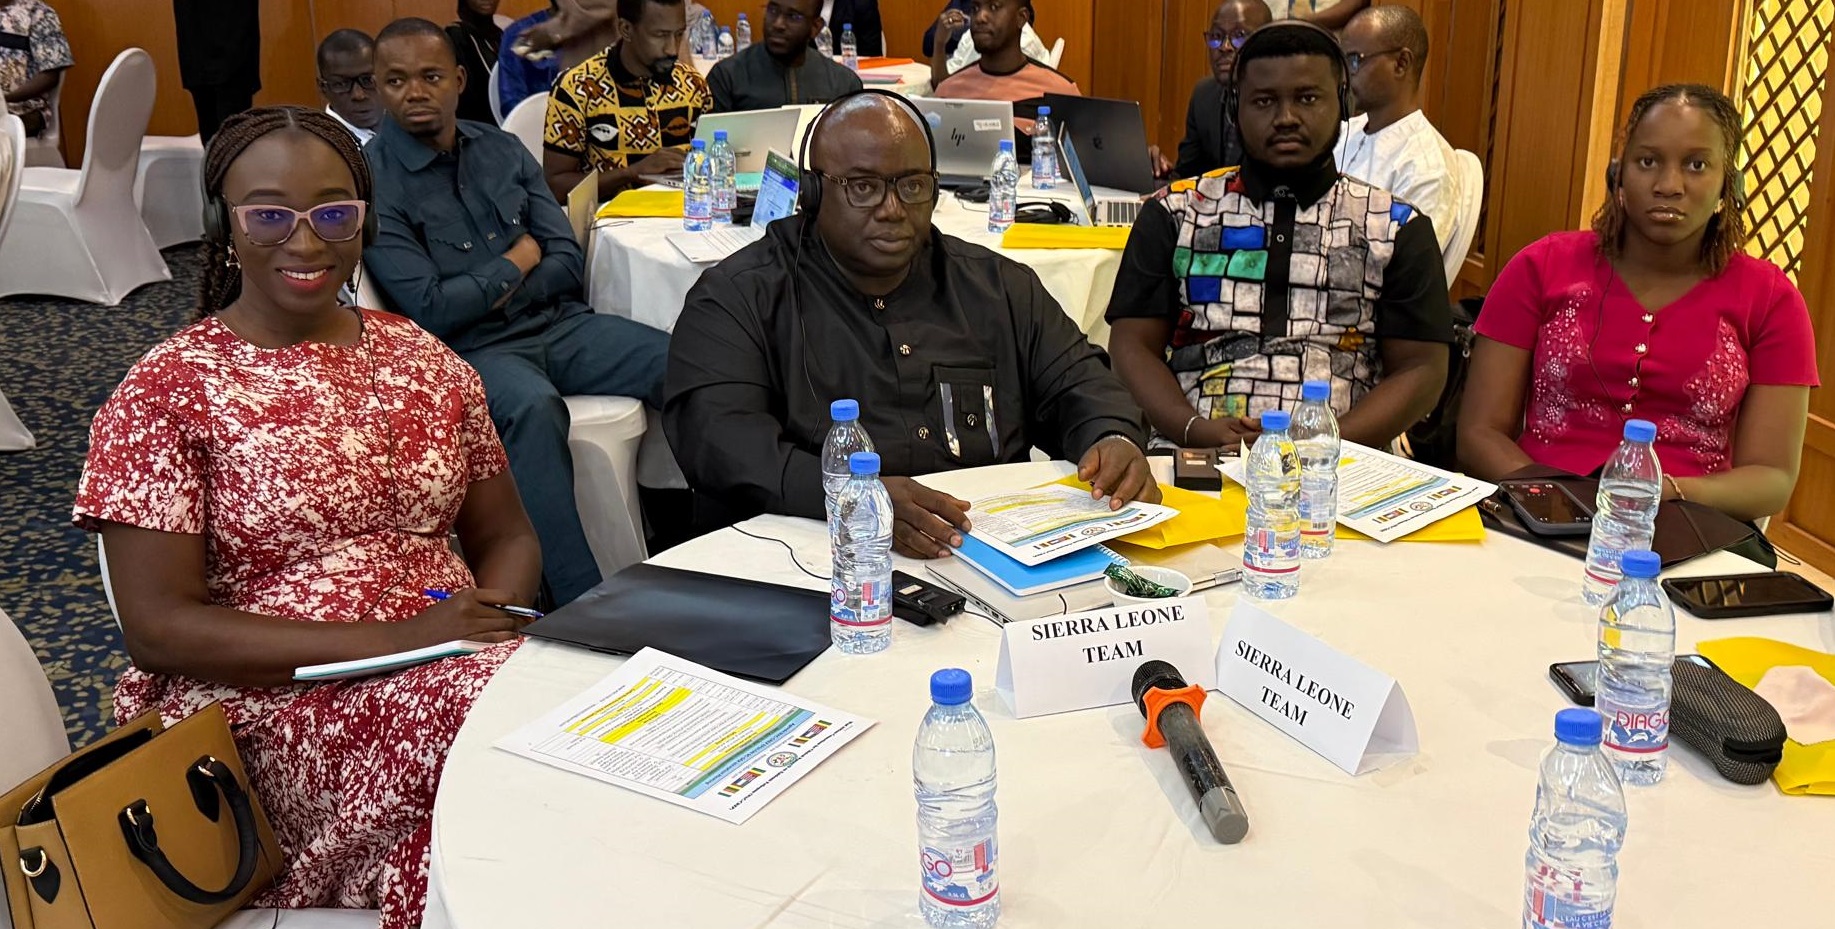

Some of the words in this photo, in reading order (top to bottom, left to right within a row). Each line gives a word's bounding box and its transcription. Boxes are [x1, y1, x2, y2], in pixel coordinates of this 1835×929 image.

[1031, 616, 1110, 641] SIERRA
[1115, 605, 1185, 630] LEONE
[1082, 640, 1144, 664] TEAM
[1235, 639, 1292, 686] SIERRA
[1295, 673, 1355, 720] LEONE
[1261, 685, 1309, 727] TEAM
[1616, 709, 1670, 729] DIAGO
